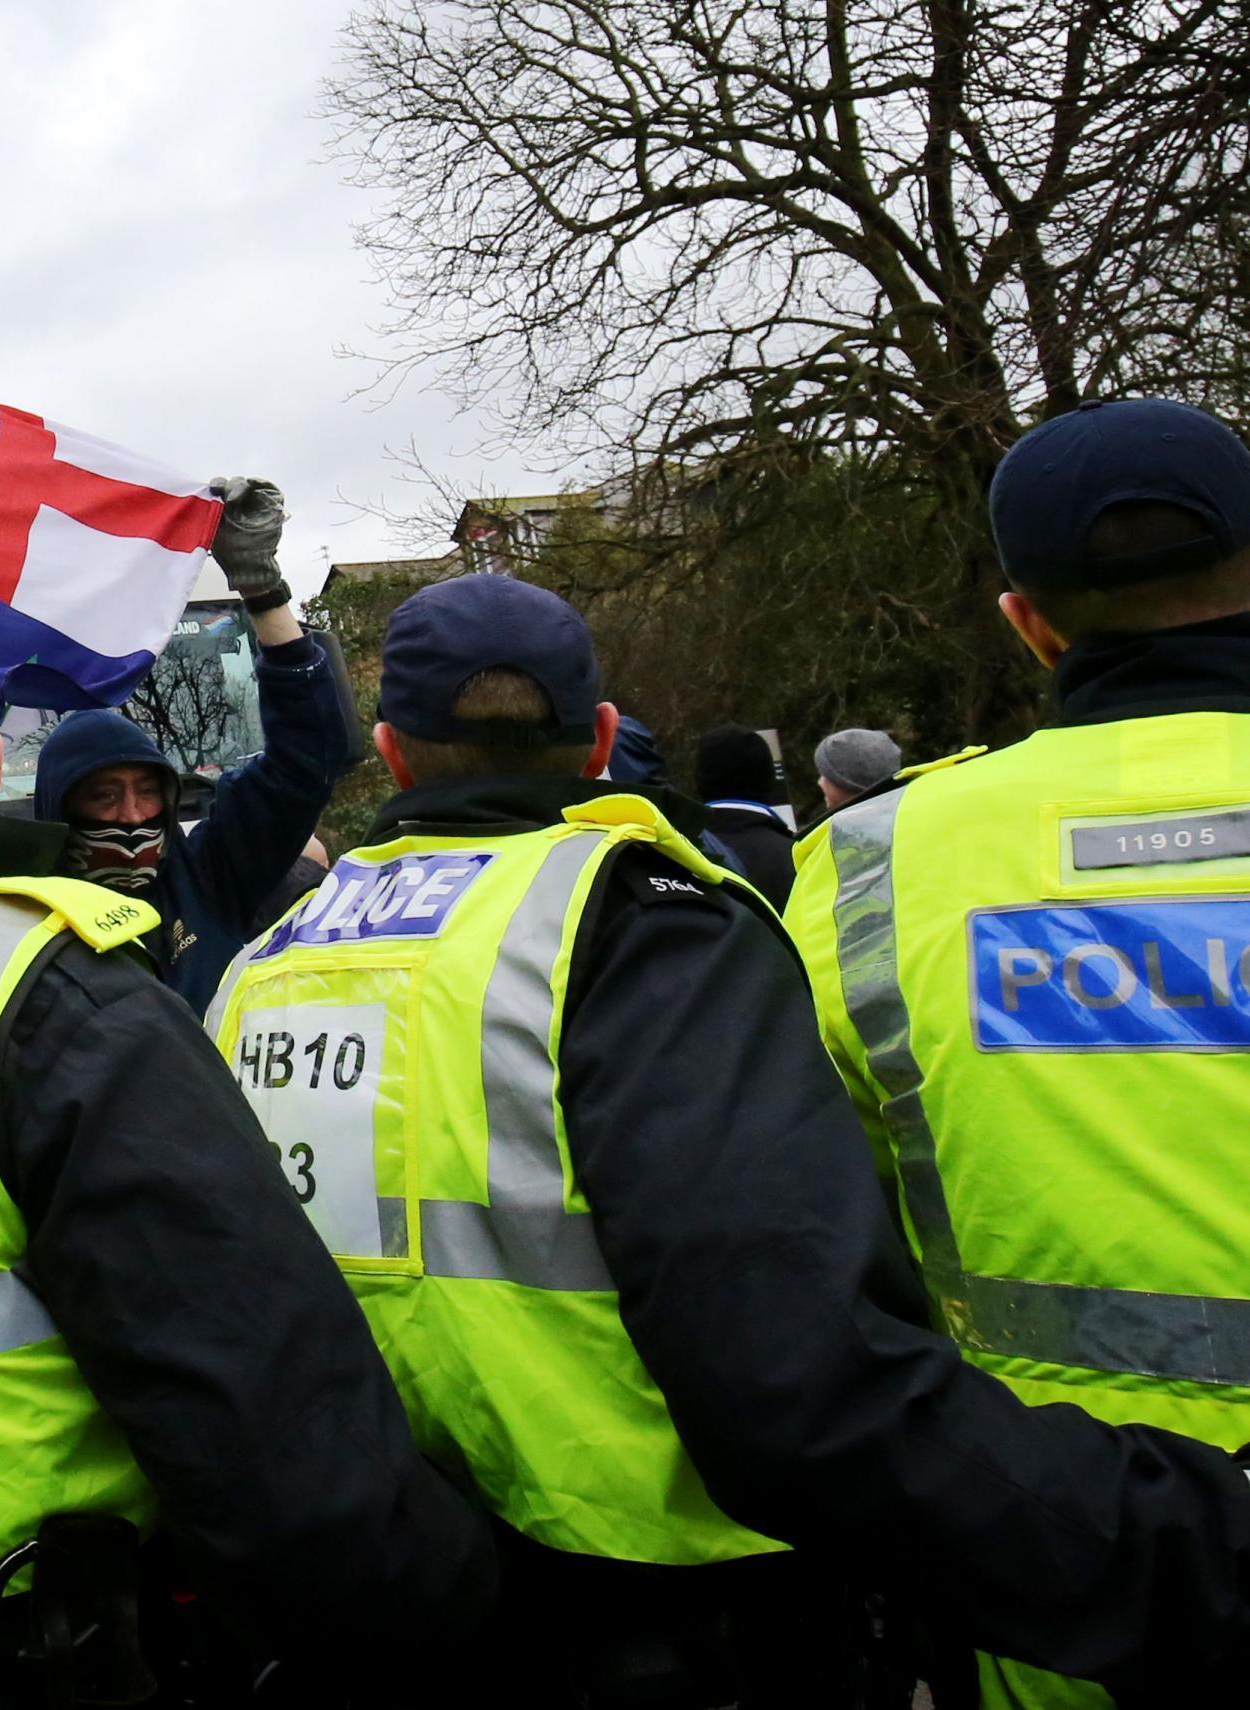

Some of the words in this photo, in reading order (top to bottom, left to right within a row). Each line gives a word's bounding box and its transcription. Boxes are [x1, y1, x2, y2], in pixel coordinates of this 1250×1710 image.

[1116, 828, 1215, 853] 11905
[95, 904, 140, 932] 6498
[998, 938, 1250, 1012] POLI
[237, 1031, 366, 1091] HB10
[268, 1140, 316, 1205] 3
